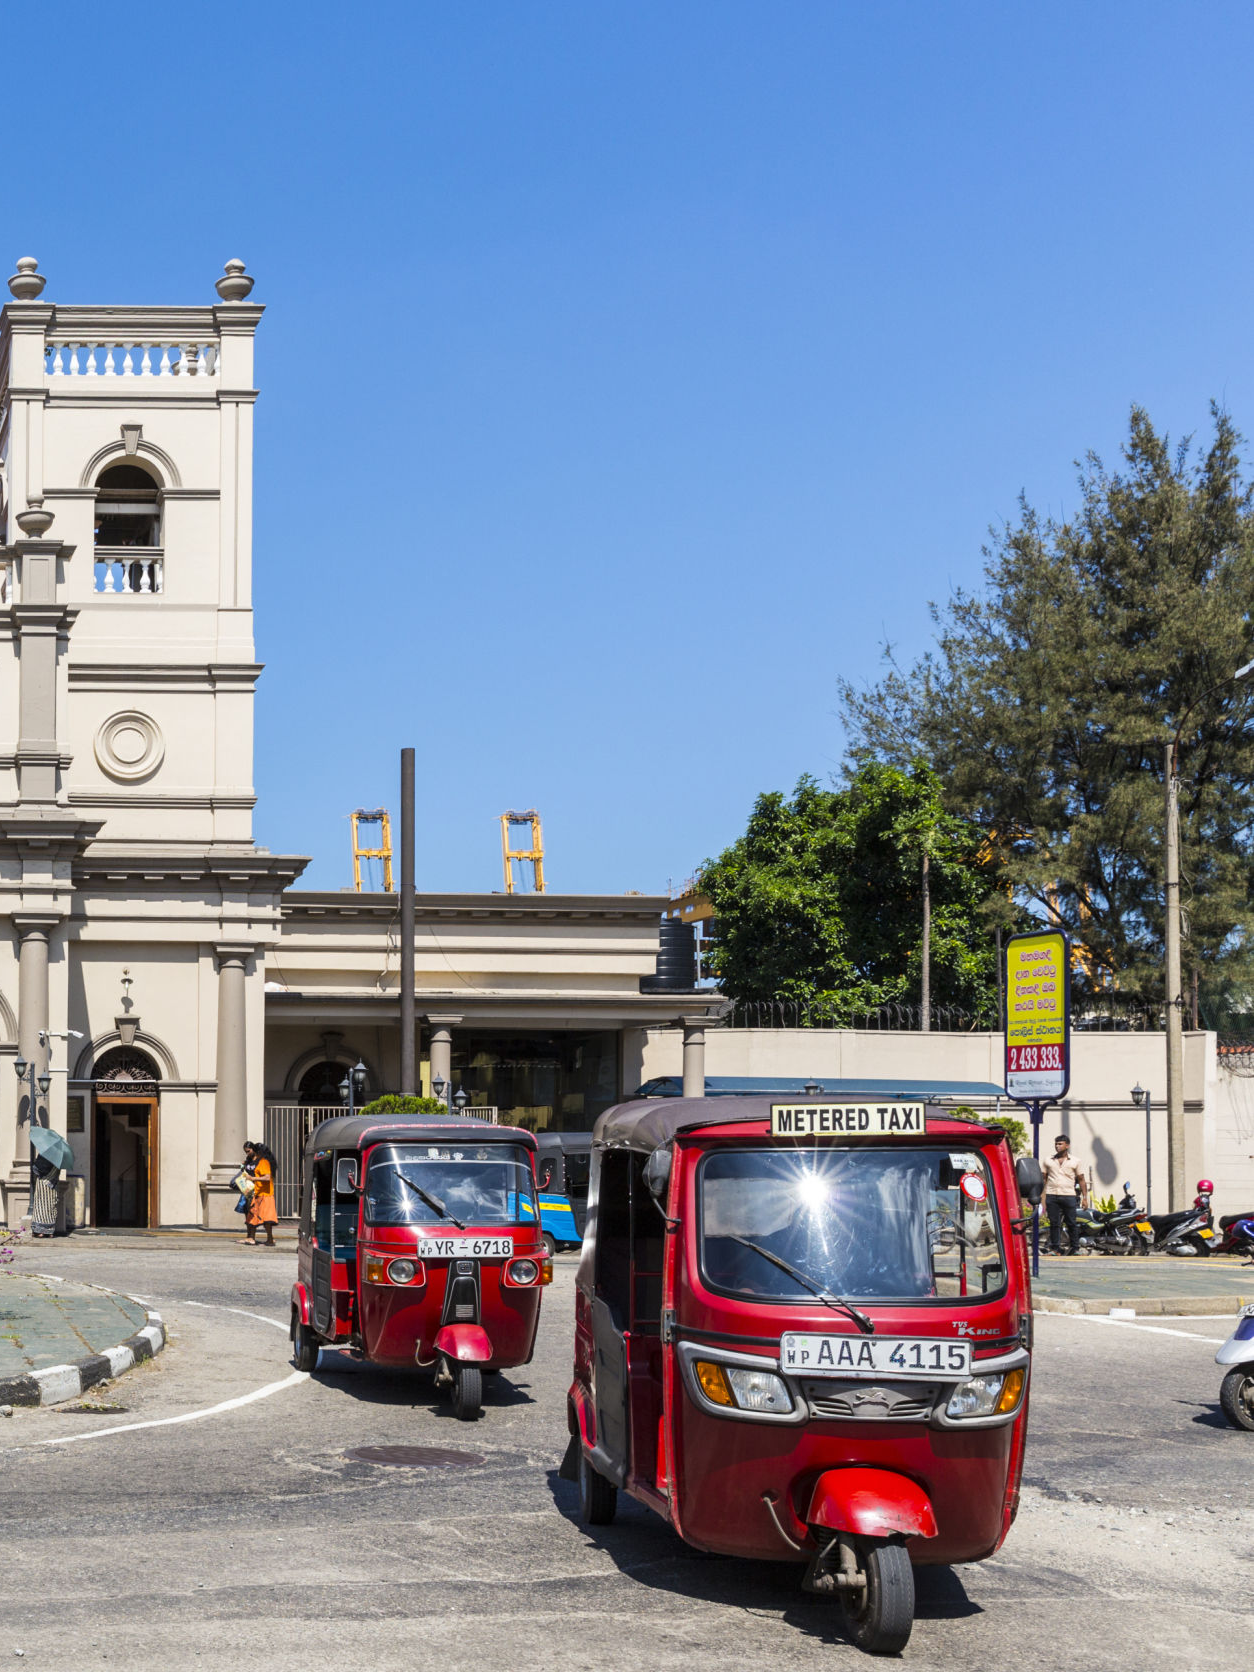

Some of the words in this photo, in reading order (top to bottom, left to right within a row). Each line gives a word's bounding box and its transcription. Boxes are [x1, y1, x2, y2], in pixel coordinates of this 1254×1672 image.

[1010, 1048, 1017, 1070] 2
[1019, 1047, 1038, 1070] 433
[777, 1108, 870, 1132] METERED
[877, 1107, 921, 1130] TAXI
[435, 1240, 454, 1255] YR
[473, 1240, 511, 1255] 6718
[957, 1326, 1001, 1337] KING
[817, 1339, 874, 1367] AAA
[889, 1342, 966, 1371] 4115
